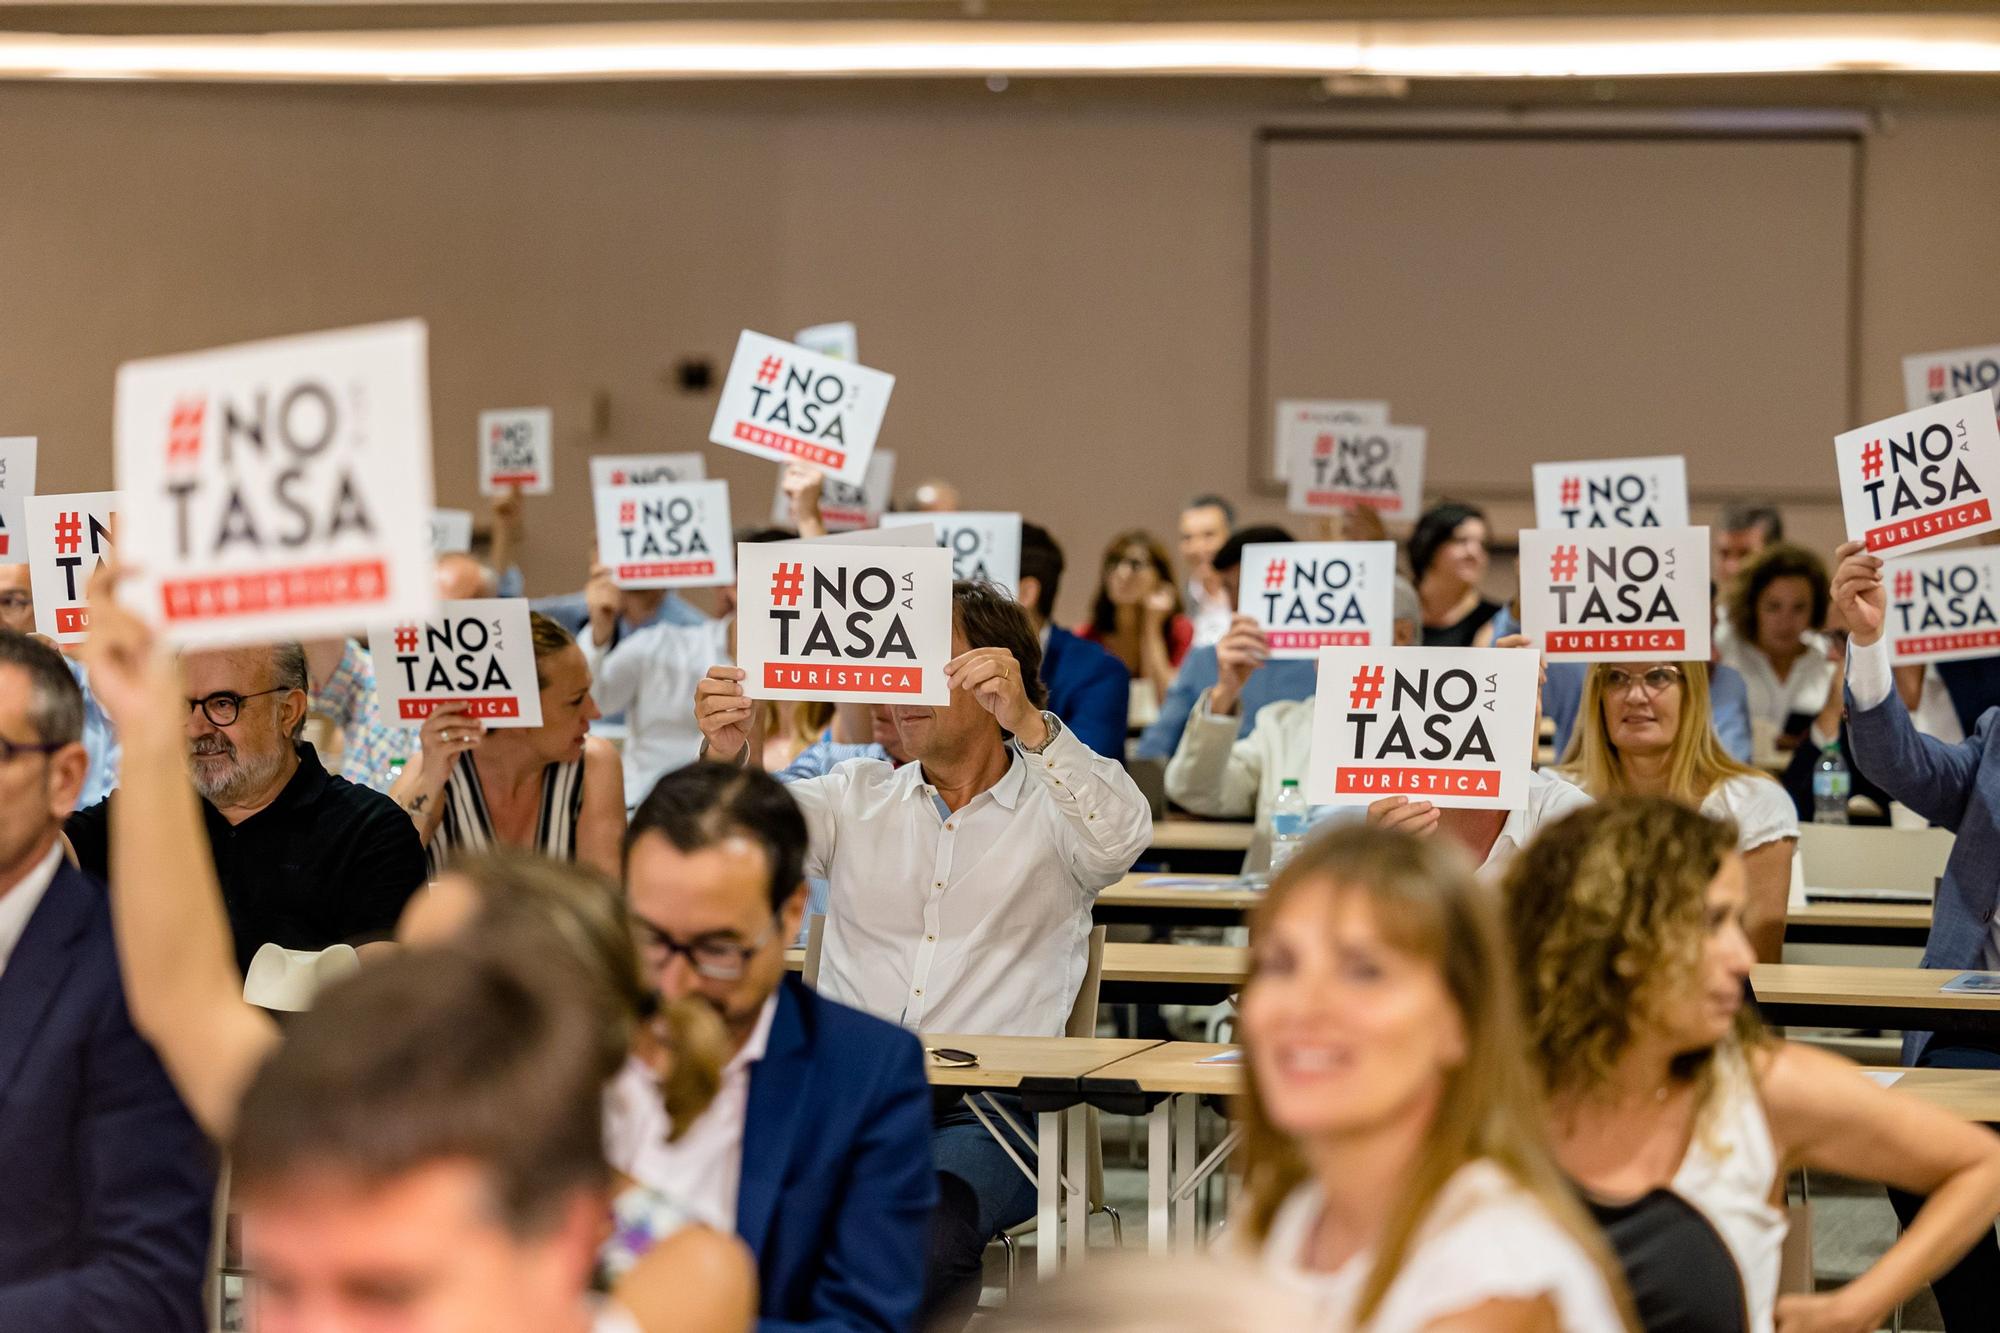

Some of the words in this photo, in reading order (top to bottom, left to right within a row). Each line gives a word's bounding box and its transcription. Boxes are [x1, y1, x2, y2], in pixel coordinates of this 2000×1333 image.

[757, 355, 844, 404] #NO
[165, 380, 339, 468] #NO
[750, 385, 845, 445] TASA
[1861, 423, 1954, 481] #NO
[1560, 474, 1646, 506] #NO
[1863, 457, 1982, 522] TASA
[164, 466, 375, 559] TASA
[1873, 508, 1983, 546] TURÍSTICA
[620, 526, 709, 558] TASA
[1664, 547, 1676, 566] LA
[901, 571, 914, 592] LA
[1264, 558, 1352, 591] #NO
[1550, 544, 1659, 583] #NO
[1894, 564, 1979, 598] #NO
[770, 562, 896, 611] #NO
[902, 598, 914, 611] A
[1549, 583, 1680, 625] TASA
[1262, 592, 1366, 625] TASA
[1894, 594, 1999, 633] TASA
[769, 609, 918, 660] TASA
[1553, 634, 1677, 649] TURÍSTICA
[396, 653, 512, 693] TASA
[774, 668, 912, 687] TURÍSTICA
[1350, 665, 1478, 713] #NO
[1484, 672, 1498, 693] LA
[1483, 699, 1496, 712] A
[1346, 712, 1496, 763] TASA
[1347, 771, 1488, 791] TURÍSTICA
